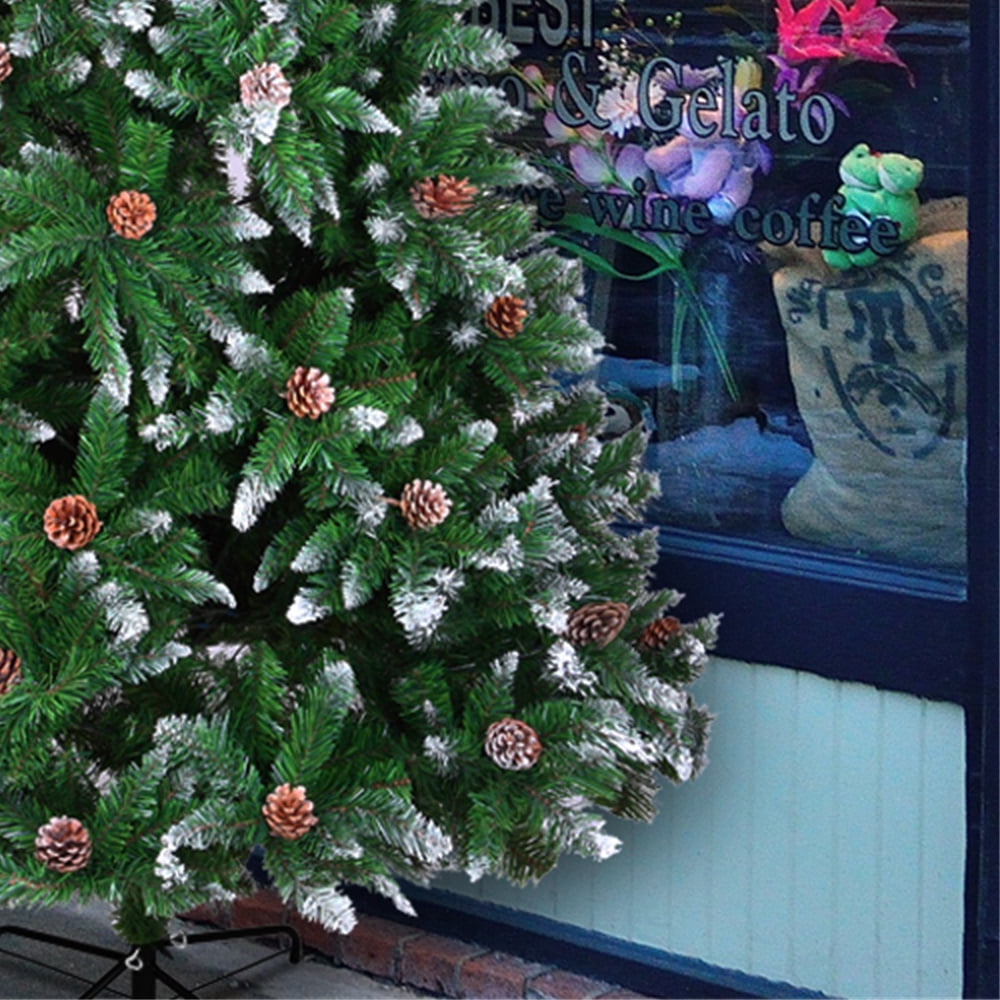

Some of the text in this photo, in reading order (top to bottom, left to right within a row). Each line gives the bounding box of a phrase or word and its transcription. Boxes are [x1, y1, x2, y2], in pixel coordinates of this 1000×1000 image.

[553, 50, 611, 130] &
[636, 55, 838, 146] Gelato
[584, 176, 714, 238] wine
[731, 192, 905, 258] coffee
